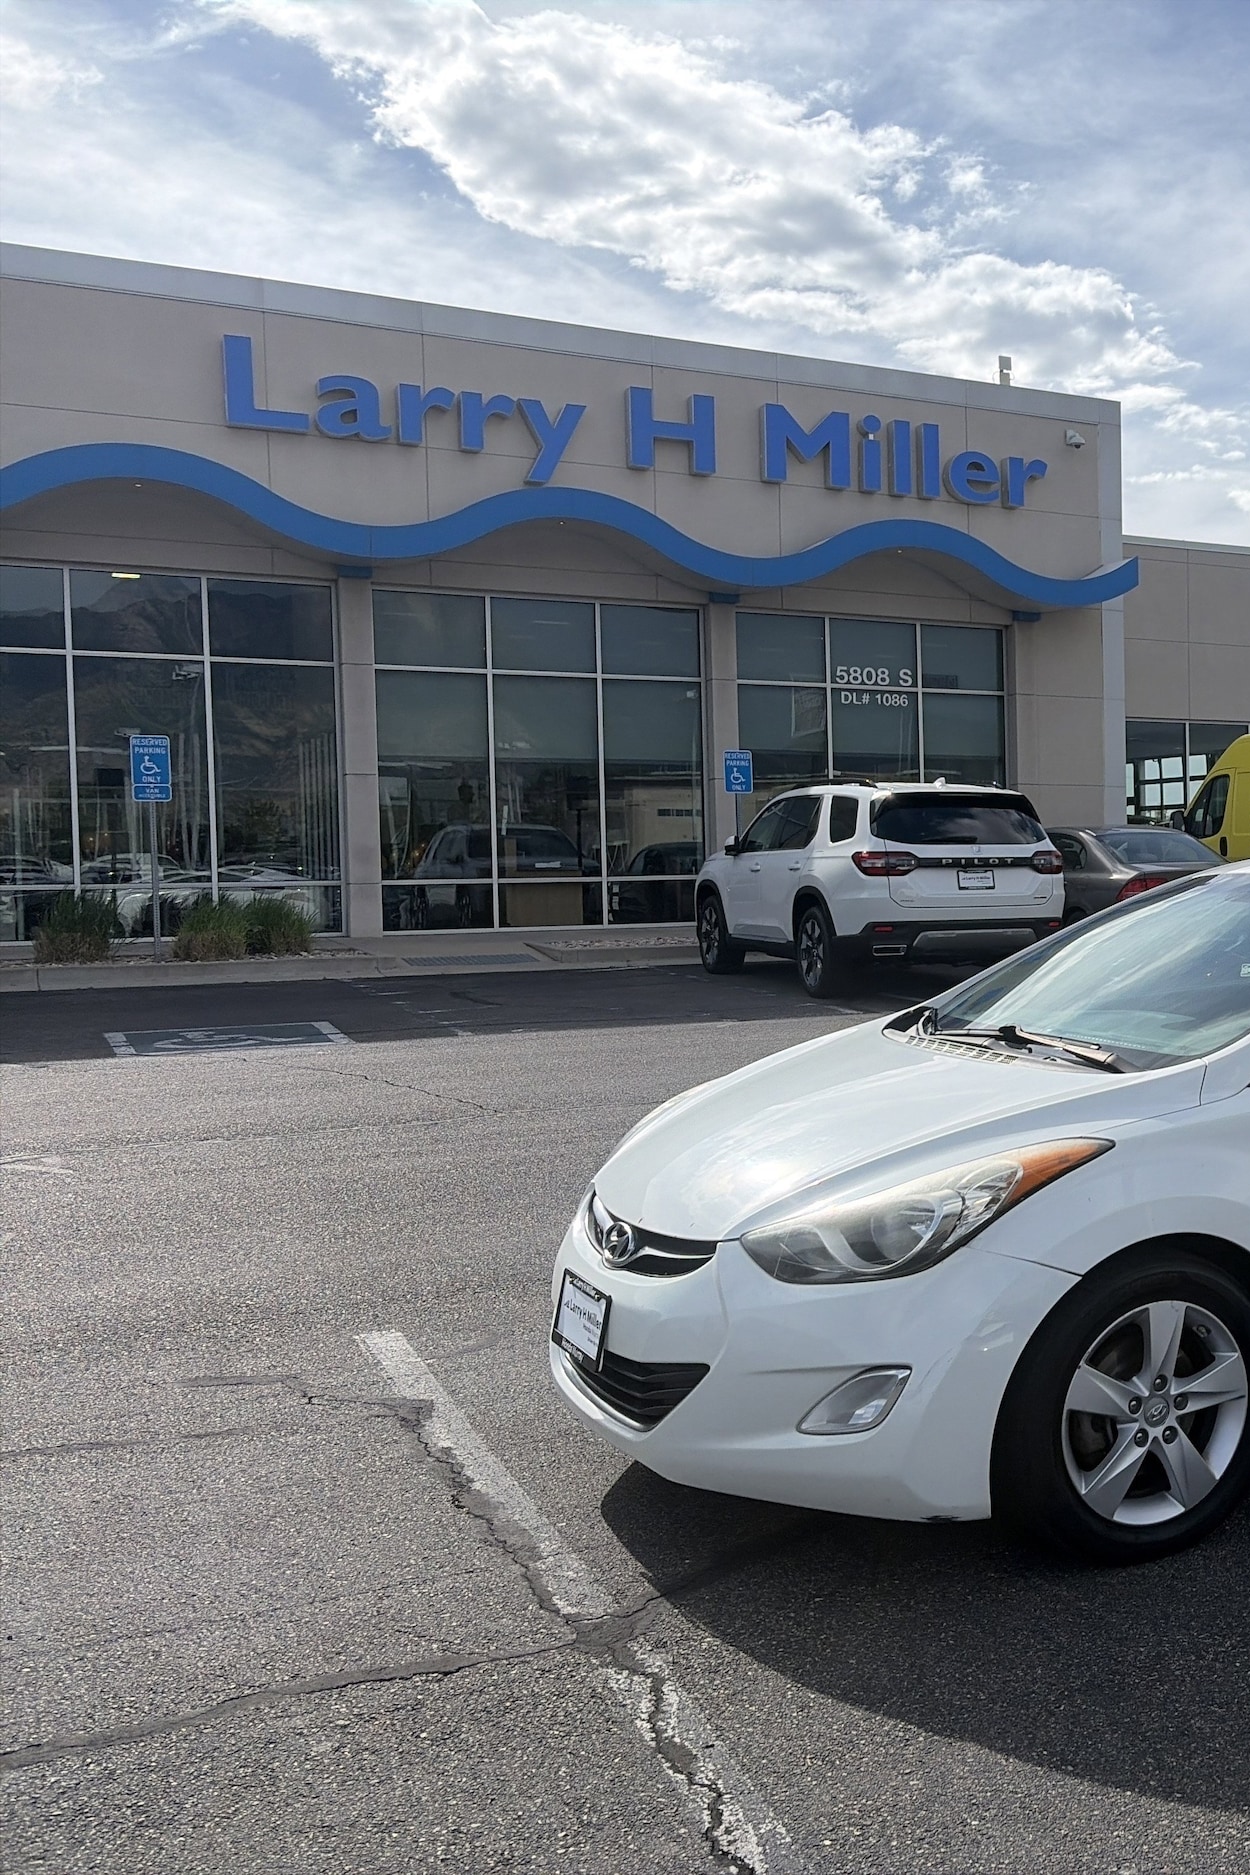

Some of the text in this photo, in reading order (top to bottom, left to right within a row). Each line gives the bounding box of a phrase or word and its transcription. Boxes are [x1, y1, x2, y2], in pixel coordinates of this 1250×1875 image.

[222, 334, 1048, 509] Larry H Miller
[835, 665, 913, 686] 5808 S
[840, 691, 909, 707] DL# 1086
[132, 738, 168, 746] RESERVED
[142, 775, 161, 783] ONLY
